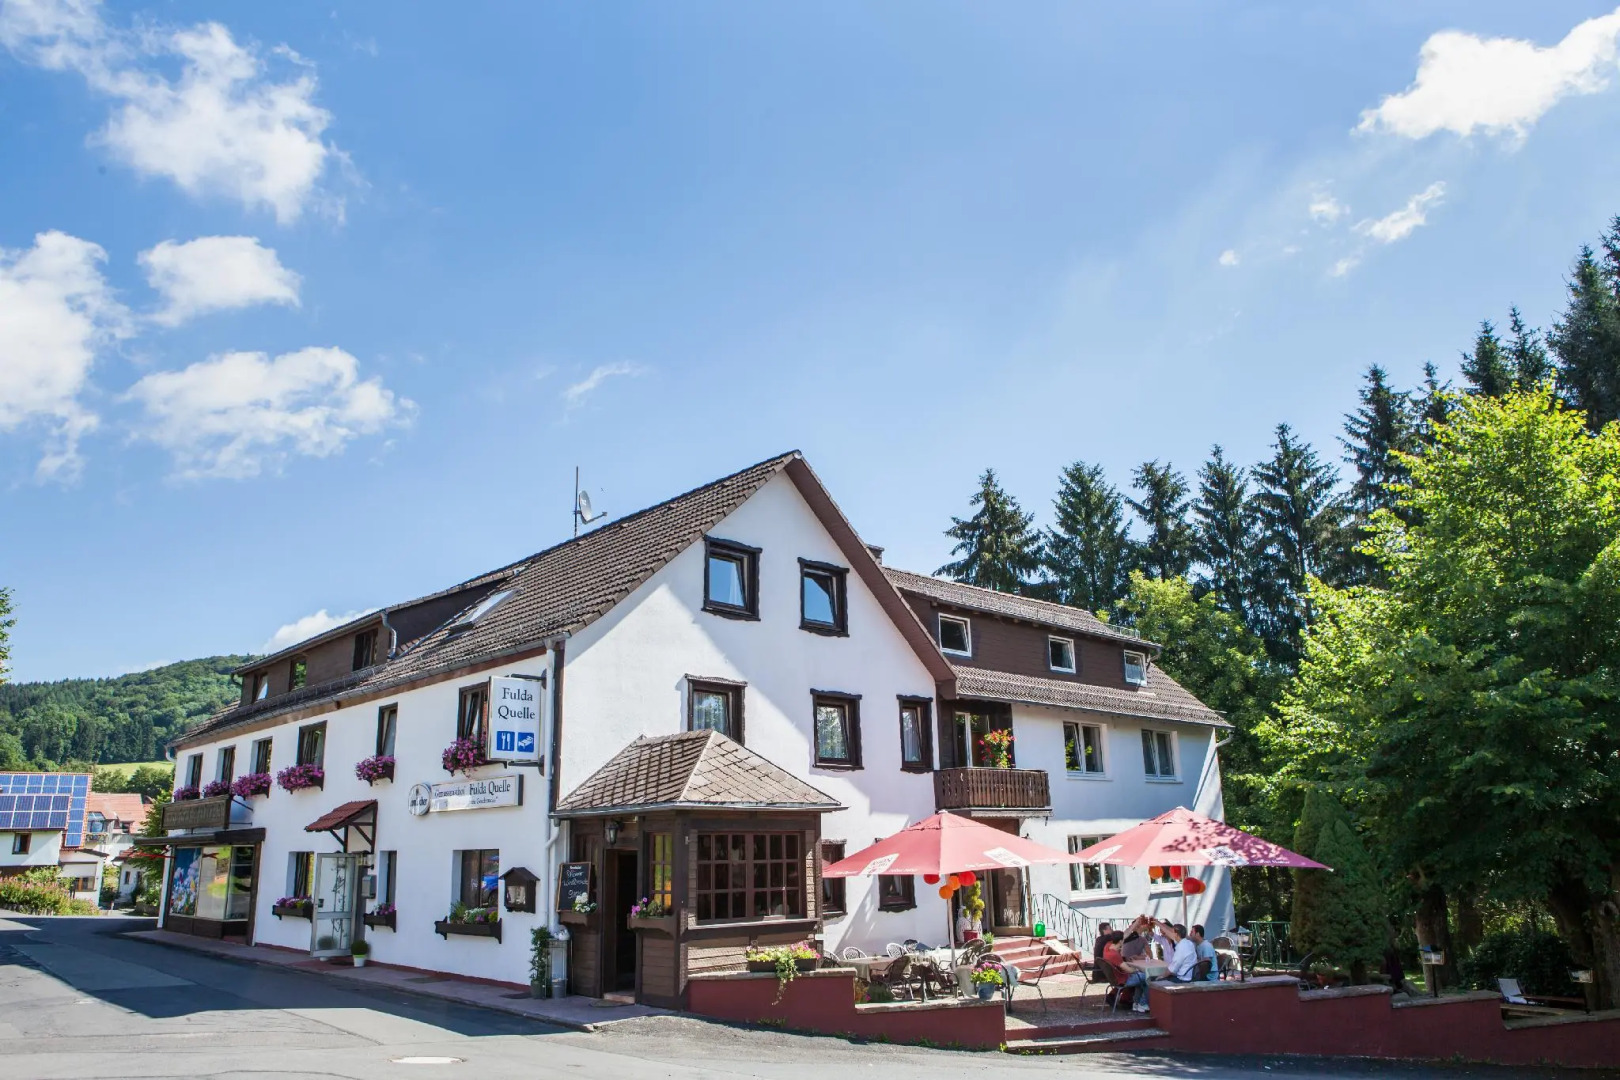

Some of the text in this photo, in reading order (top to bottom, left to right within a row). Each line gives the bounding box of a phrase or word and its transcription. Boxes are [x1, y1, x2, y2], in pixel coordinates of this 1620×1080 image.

[502, 687, 533, 701] Fulda
[497, 705, 536, 720] Quelle
[469, 781, 487, 796] Fulda
[488, 780, 511, 796] Quelle
